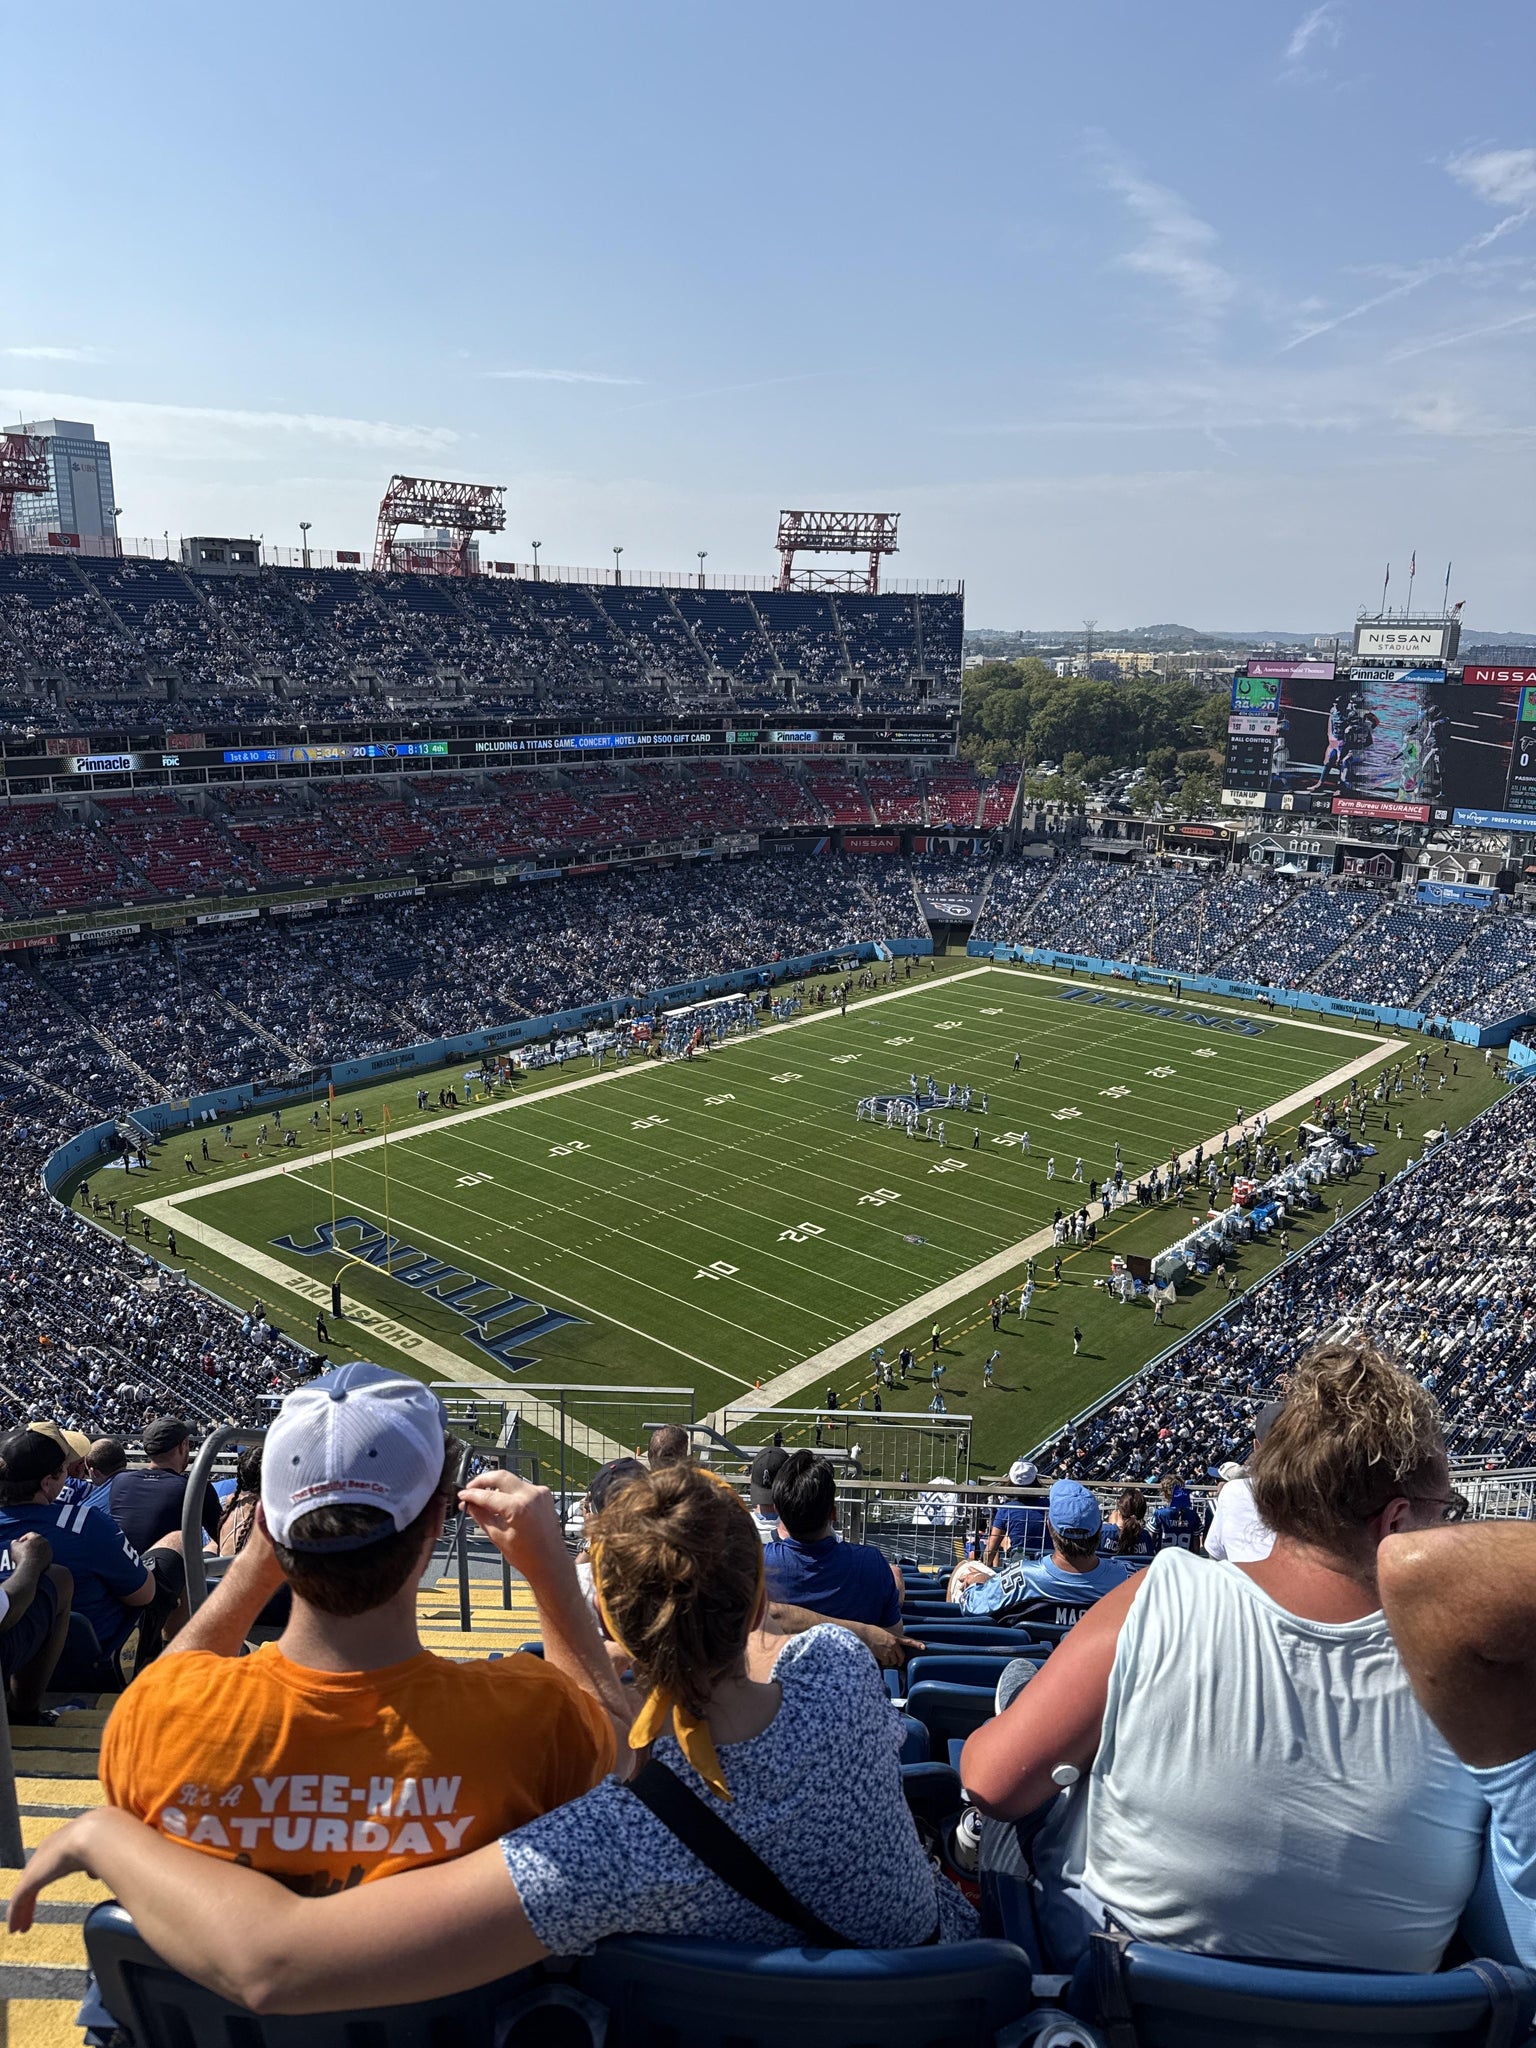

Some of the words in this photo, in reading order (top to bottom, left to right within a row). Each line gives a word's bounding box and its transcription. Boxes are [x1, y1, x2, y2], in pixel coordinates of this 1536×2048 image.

[81, 464, 96, 472] UBS
[1369, 634, 1432, 643] NISSAN
[1351, 669, 1395, 680] Pinnacle
[1234, 700, 1249, 709] 34
[1261, 701, 1275, 711] 20
[475, 742, 518, 752] INCLUDING
[519, 741, 525, 750] A
[527, 740, 552, 749] TITANS
[554, 739, 578, 748] GAME,
[579, 737, 613, 748] CONCERT,
[615, 736, 636, 745] HOTEL
[637, 735, 652, 744] AND
[653, 735, 672, 744] $500
[674, 734, 689, 743] GIFT
[691, 733, 710, 742] CARD
[777, 732, 811, 741] Pinnacle
[230, 753, 241, 761] 1st
[250, 753, 259, 761] 10
[325, 748, 339, 758] 34
[353, 748, 366, 757] 20
[408, 744, 429, 755] 8:13
[432, 745, 444, 753] 4th
[76, 756, 131, 771] Pinnacle
[162, 758, 179, 767] FDIC
[1520, 753, 1529, 766] 0
[1356, 801, 1379, 809] Bureau
[1381, 803, 1423, 813] INSURANCE
[1467, 812, 1488, 824] Kroger
[374, 891, 397, 900] ROCKY
[398, 889, 413, 898] LAW
[173, 928, 194, 936] MOON
[1228, 985, 1252, 996] TENNESSEE
[1056, 984, 1279, 1037] TITANS
[1331, 1002, 1357, 1015] TENNESSEE
[1358, 1006, 1375, 1017] TOUGH
[371, 1057, 399, 1070] TENNESSEE
[769, 1071, 804, 1083] 50
[1146, 1065, 1176, 1079] 20
[1098, 1085, 1132, 1099] 30
[704, 1093, 737, 1106] 40
[1051, 1106, 1083, 1121] 40
[631, 1115, 669, 1130] 30
[991, 1131, 1025, 1147] 50
[548, 1140, 591, 1157] 20
[930, 1158, 969, 1174] 40
[455, 1171, 495, 1188] 10
[857, 1187, 902, 1208] 30
[778, 1221, 827, 1243] 20
[695, 1260, 741, 1281] 10
[267, 1216, 594, 1373] TITANS
[284, 1276, 333, 1306] OVE
[341, 1302, 423, 1350] CHOOSE
[1104, 1537, 1148, 1554] RICSON
[177, 1783, 211, 1807] It's
[219, 1784, 244, 1808] A
[253, 1774, 462, 1817] YEE-HAW
[160, 1806, 476, 1855] SATURDAY
